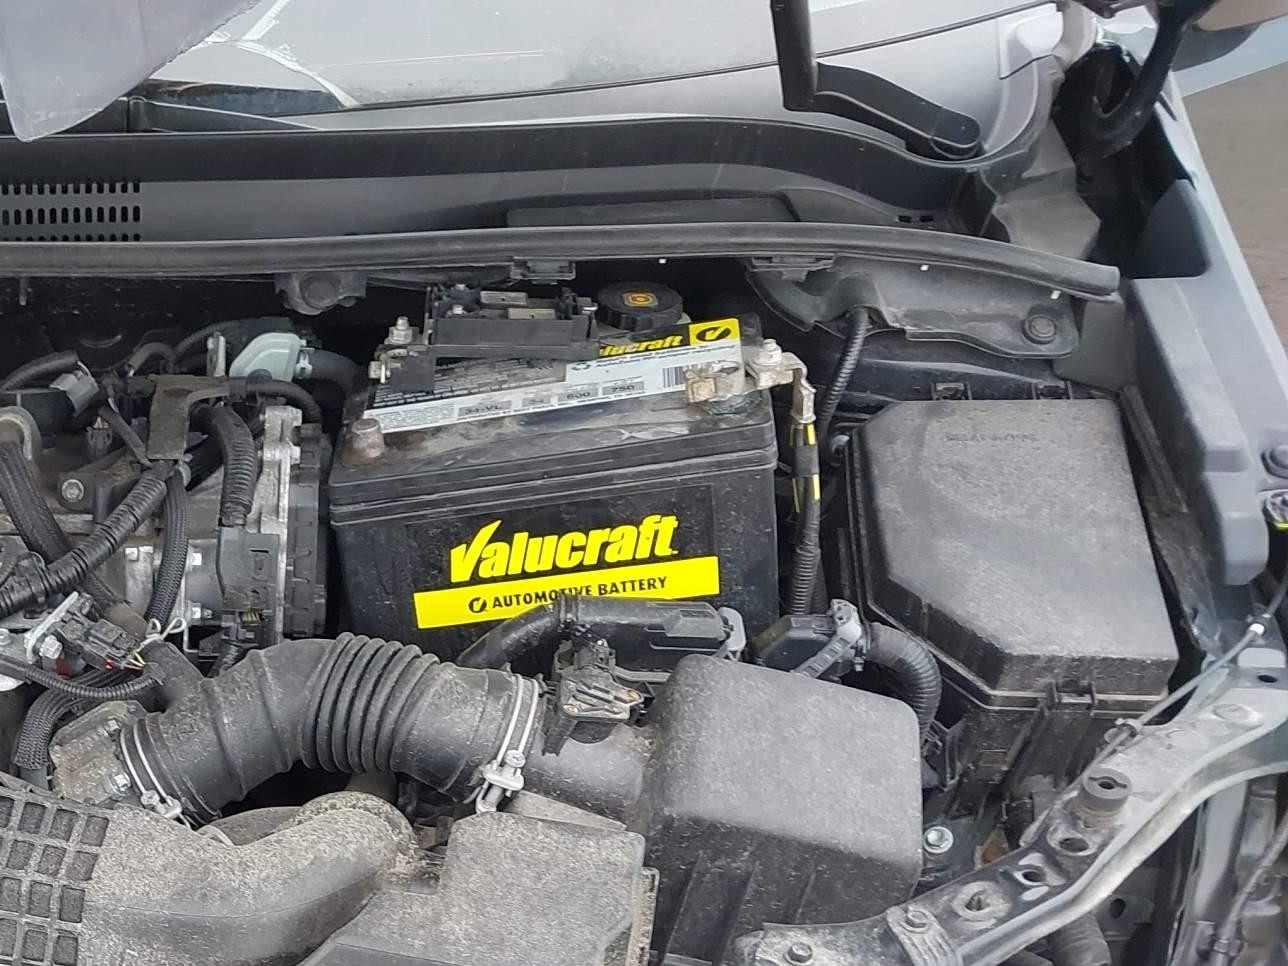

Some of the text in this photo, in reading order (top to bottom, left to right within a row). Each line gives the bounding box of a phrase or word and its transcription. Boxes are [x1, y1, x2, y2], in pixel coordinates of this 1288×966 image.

[599, 335, 684, 357] lucraft
[450, 514, 678, 583] Valucraft
[598, 576, 668, 595] BATTERY
